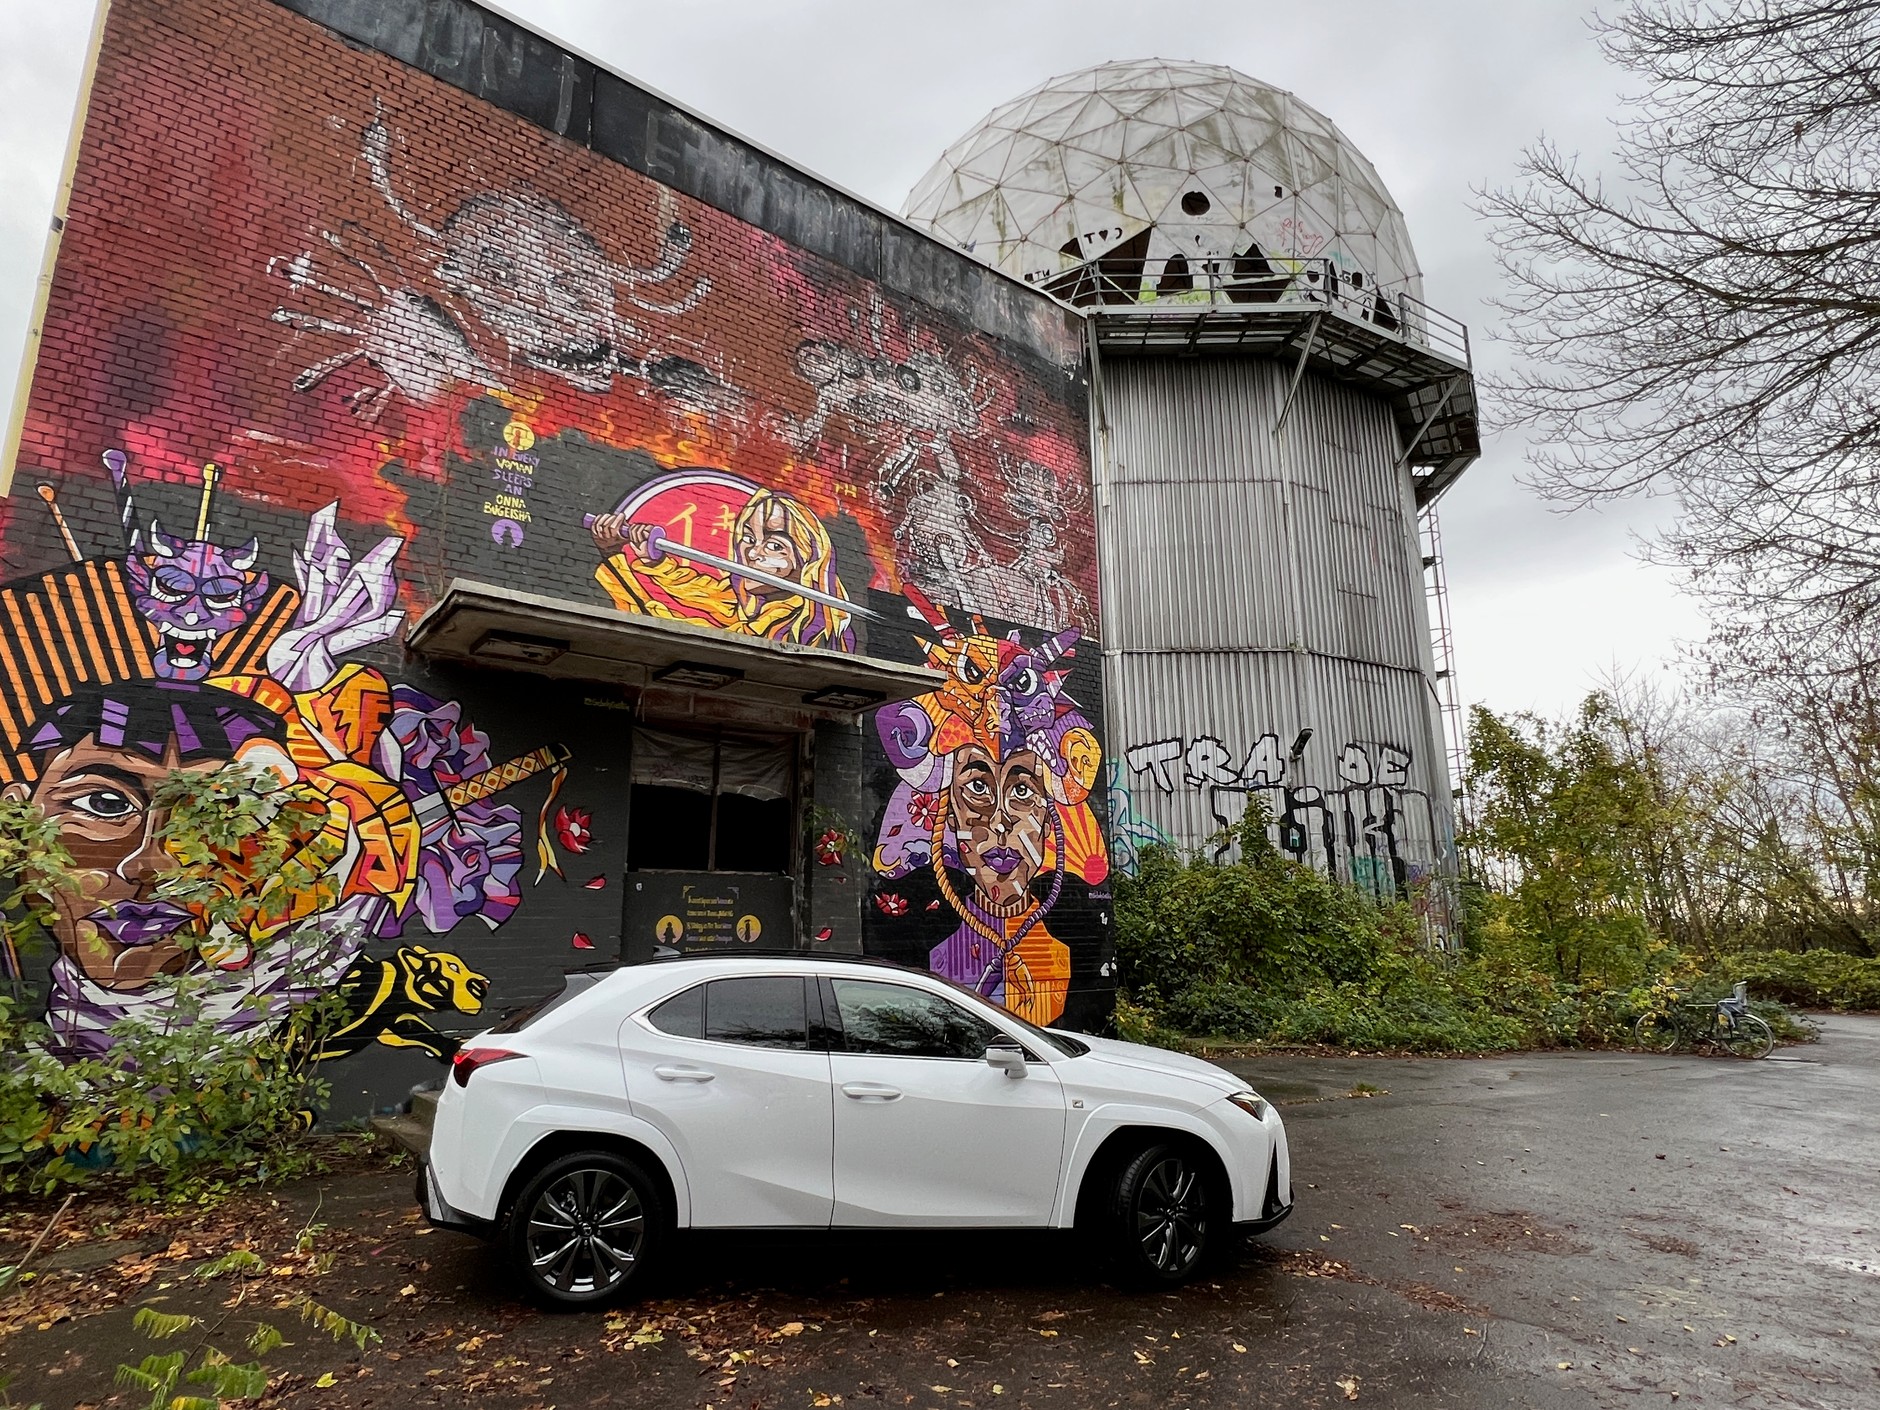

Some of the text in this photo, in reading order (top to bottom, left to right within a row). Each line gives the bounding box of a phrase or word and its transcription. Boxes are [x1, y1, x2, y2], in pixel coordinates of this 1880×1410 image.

[491, 446, 541, 467] IN EVERY
[492, 469, 533, 488] SLEEPS
[504, 484, 523, 496] AN
[496, 494, 527, 508] ONNA
[483, 501, 532, 523] BUGEISHA
